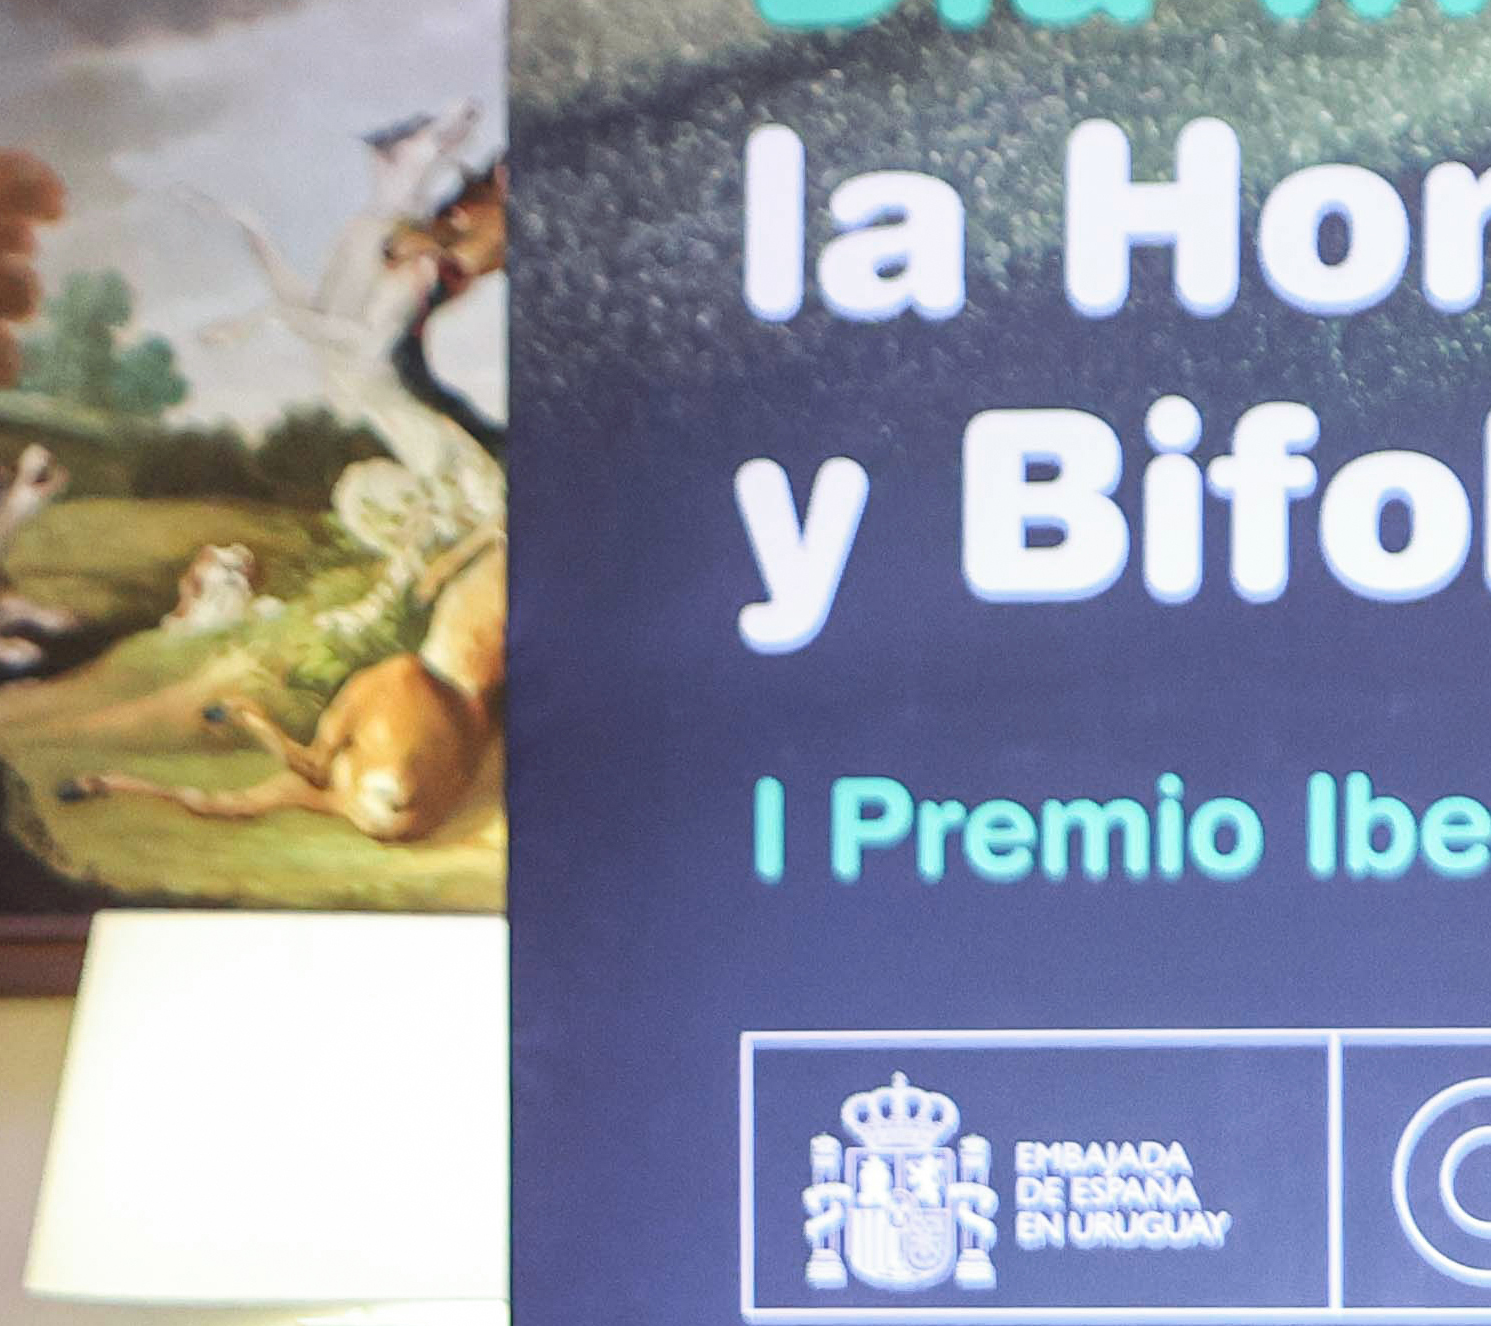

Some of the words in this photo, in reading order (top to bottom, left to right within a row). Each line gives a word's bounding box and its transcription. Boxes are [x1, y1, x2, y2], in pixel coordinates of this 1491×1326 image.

[744, 123, 967, 321] la
[734, 455, 870, 655] y
[756, 775, 785, 883] I
[830, 770, 1265, 885] Premio
[1015, 1141, 1193, 1175] EMBAJADA
[1015, 1175, 1065, 1210] DE
[1069, 1172, 1201, 1210] ESPAÑA
[1015, 1211, 1065, 1250] EN
[1068, 1211, 1233, 1250] URUGUAY
